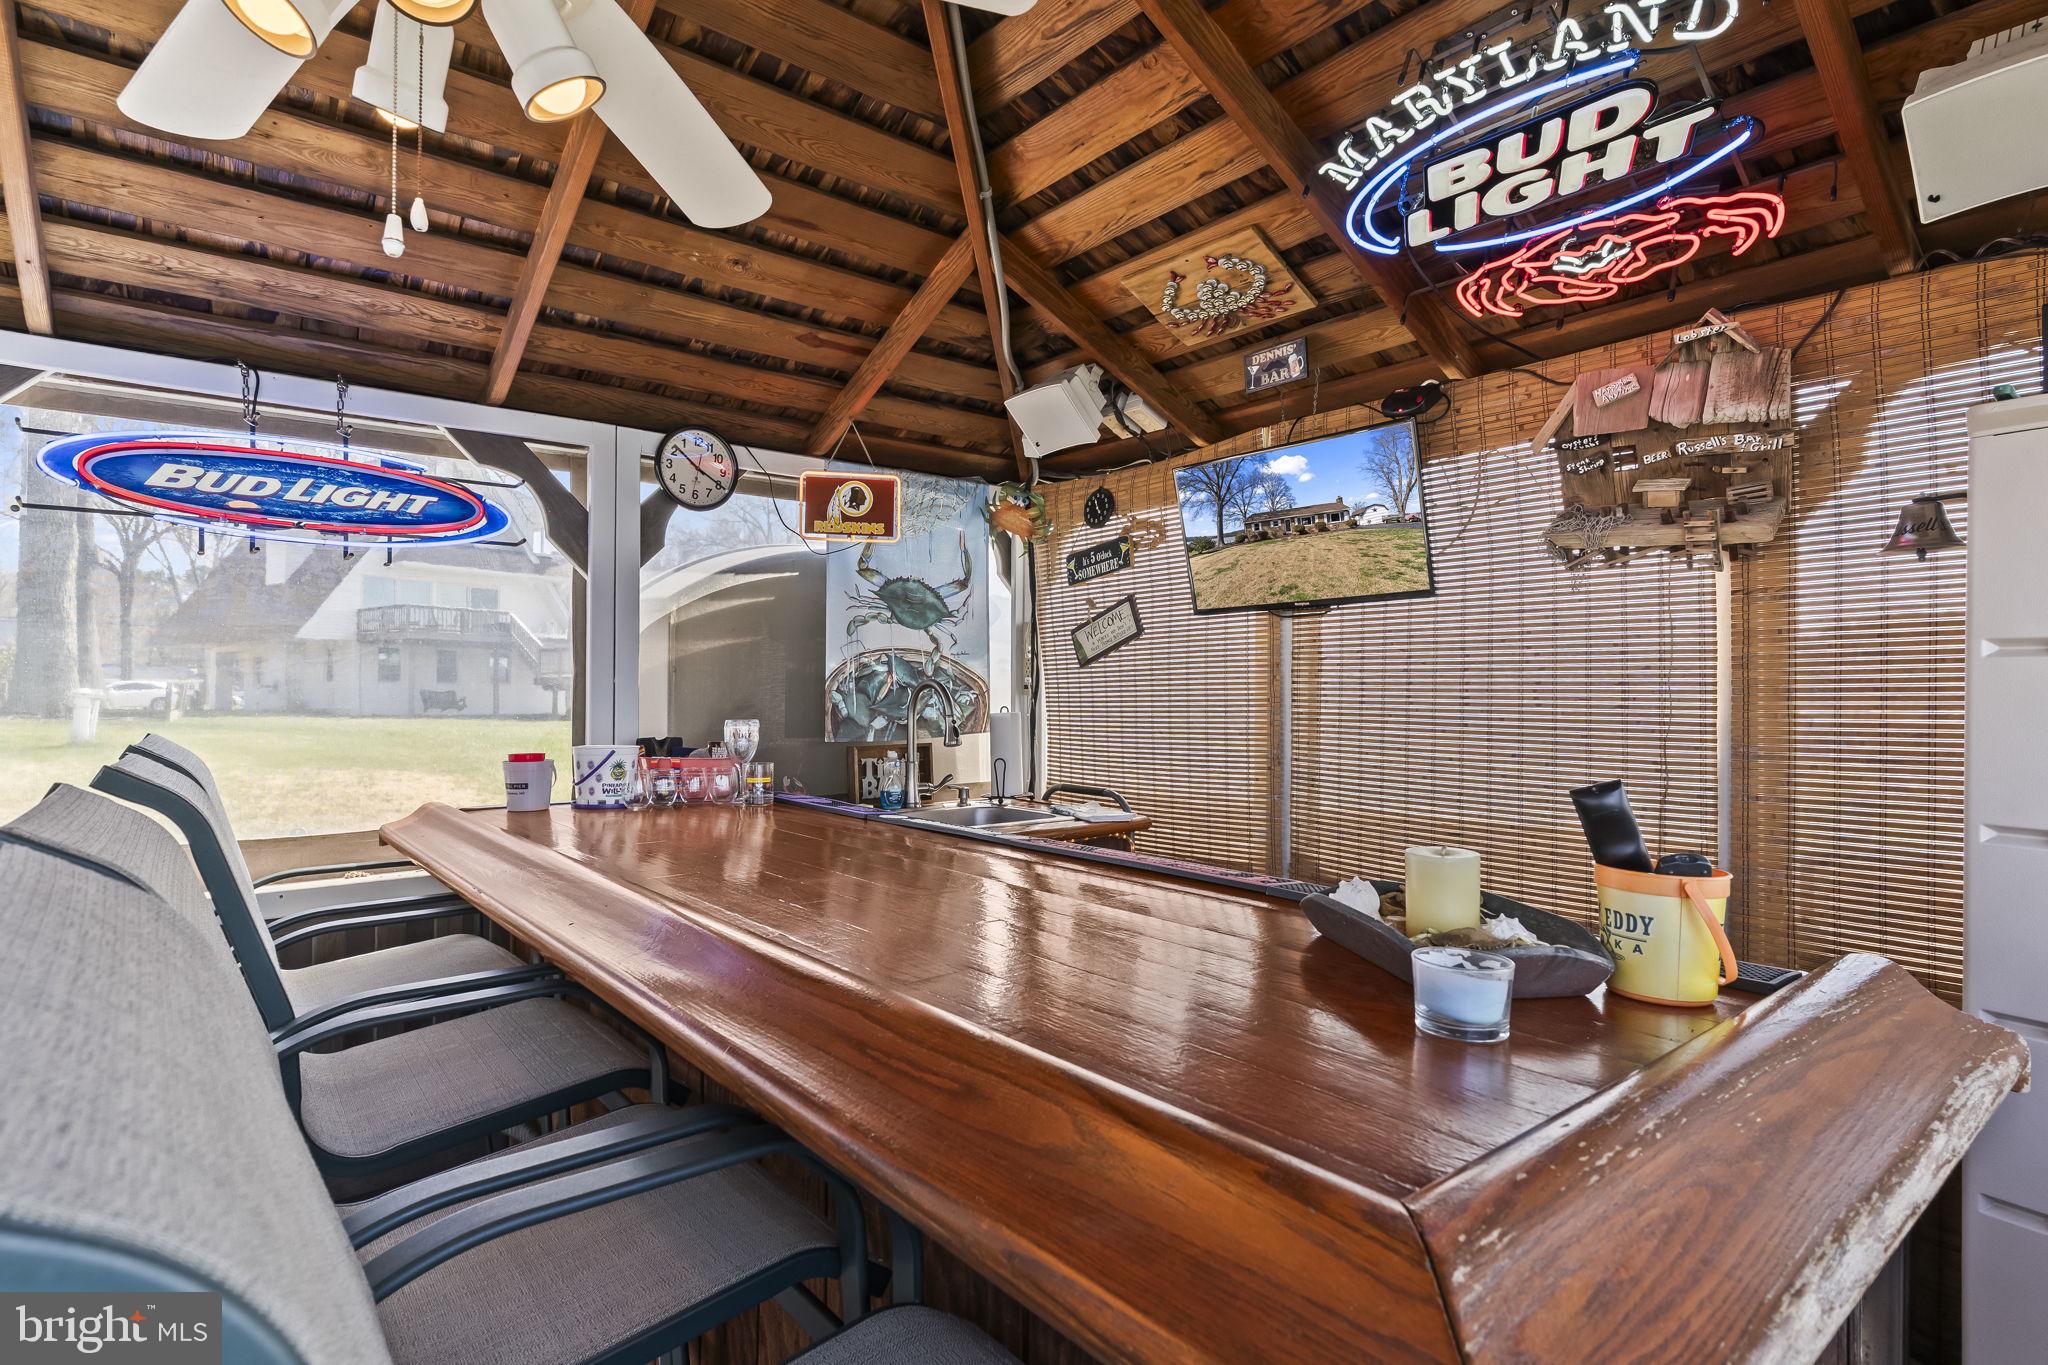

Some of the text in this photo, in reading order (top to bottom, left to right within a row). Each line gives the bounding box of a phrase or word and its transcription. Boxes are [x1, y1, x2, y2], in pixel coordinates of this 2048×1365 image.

[1319, 0, 1739, 192] MARYLAND
[1426, 87, 1658, 201] BUD
[1407, 106, 1716, 248] LIGHT
[1676, 325, 1727, 344] Lobster
[1252, 344, 1297, 365] DENNIS'
[1261, 367, 1290, 386] BAR
[671, 446, 678, 456] 2
[681, 439, 686, 448] 1
[706, 442, 714, 453] 11
[1675, 435, 1727, 456] Russell's
[1750, 437, 1783, 451] Grill
[666, 459, 673, 469] 3
[713, 454, 724, 464] 10
[1643, 450, 1669, 465] BEER
[669, 473, 677, 483] 4
[720, 469, 727, 477] 9
[143, 463, 439, 514] BUD LIGHT
[679, 484, 686, 494] 5
[692, 490, 699, 499] 6
[706, 488, 713, 498] 7
[813, 519, 885, 535] REDSKINS
[1090, 551, 1096, 564] 5
[1077, 558, 1119, 580] SOMEWHERE
[1084, 609, 1127, 642] WELCOME
[1604, 907, 1654, 936] EDDY
